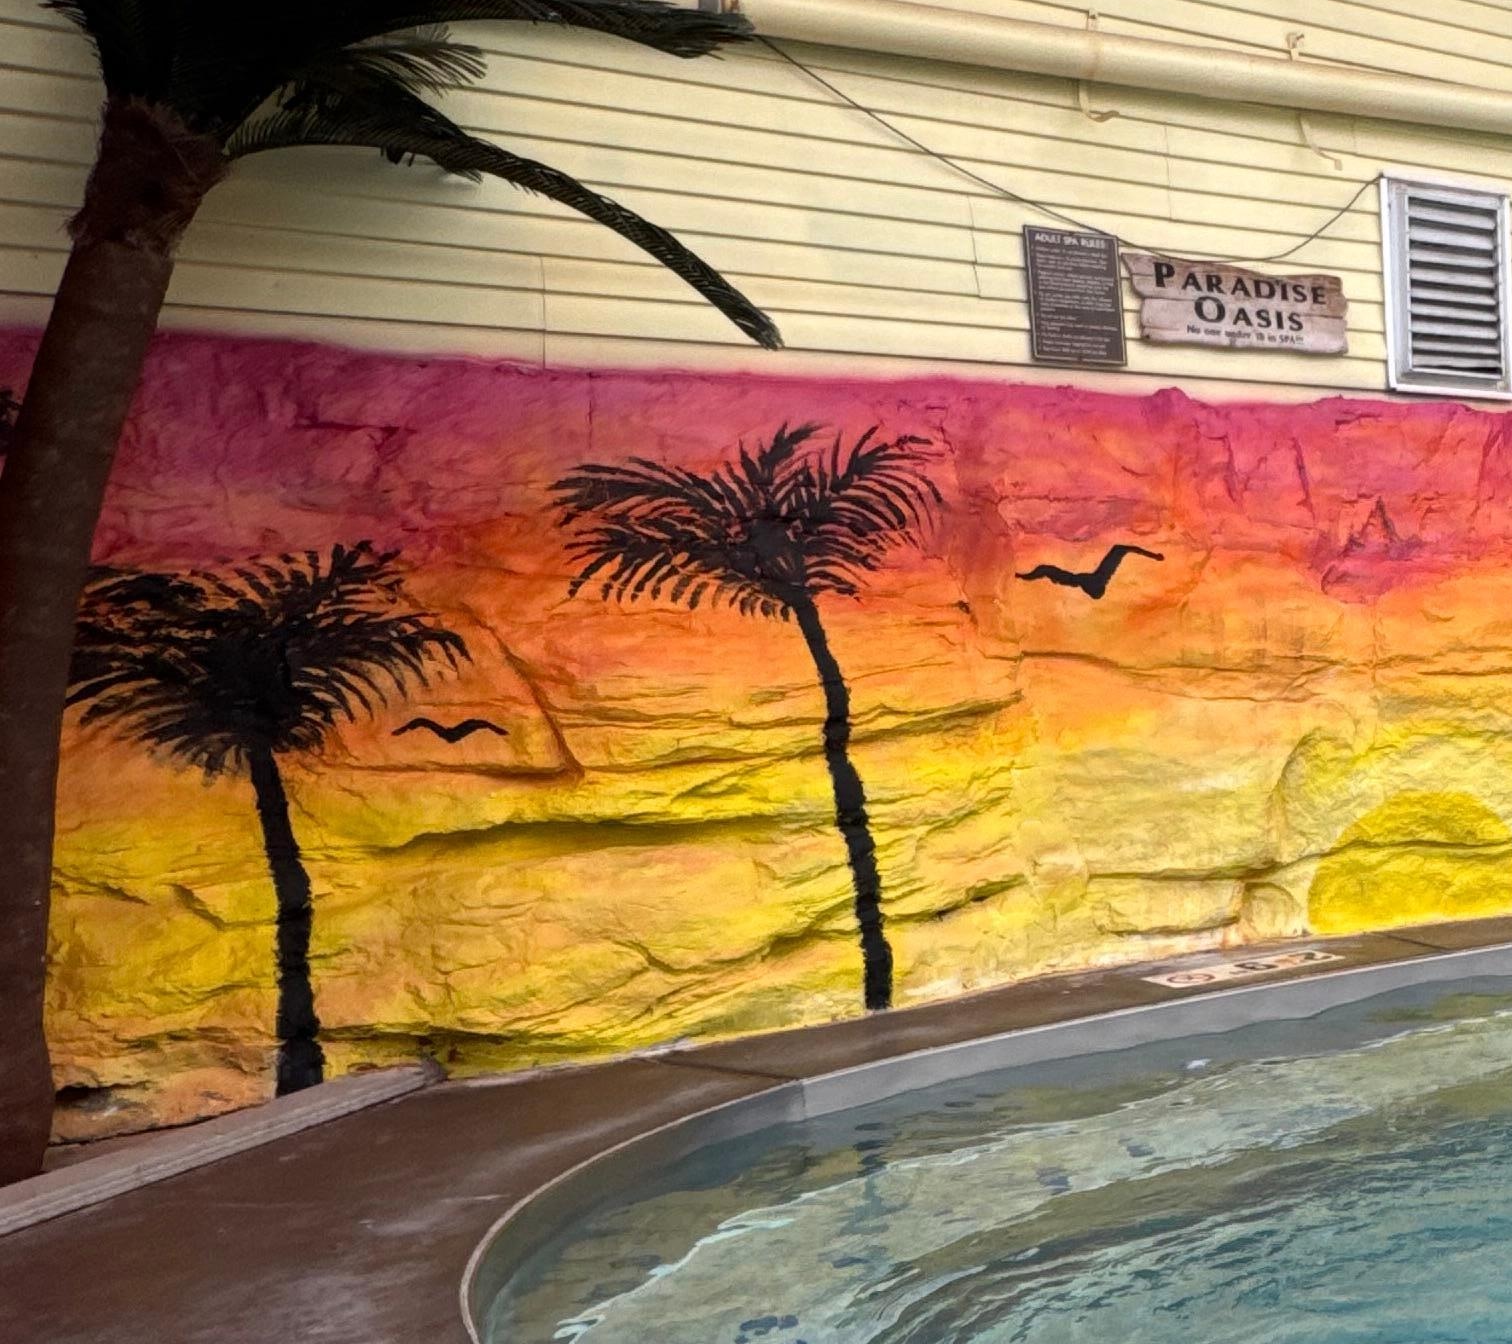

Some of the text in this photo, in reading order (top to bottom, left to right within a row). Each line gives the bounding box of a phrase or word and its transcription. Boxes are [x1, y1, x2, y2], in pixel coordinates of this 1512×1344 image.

[1153, 261, 1327, 305] PARADISE
[1187, 324, 1201, 335] No
[1225, 329, 1251, 339] under
[1194, 296, 1304, 332] OASIS
